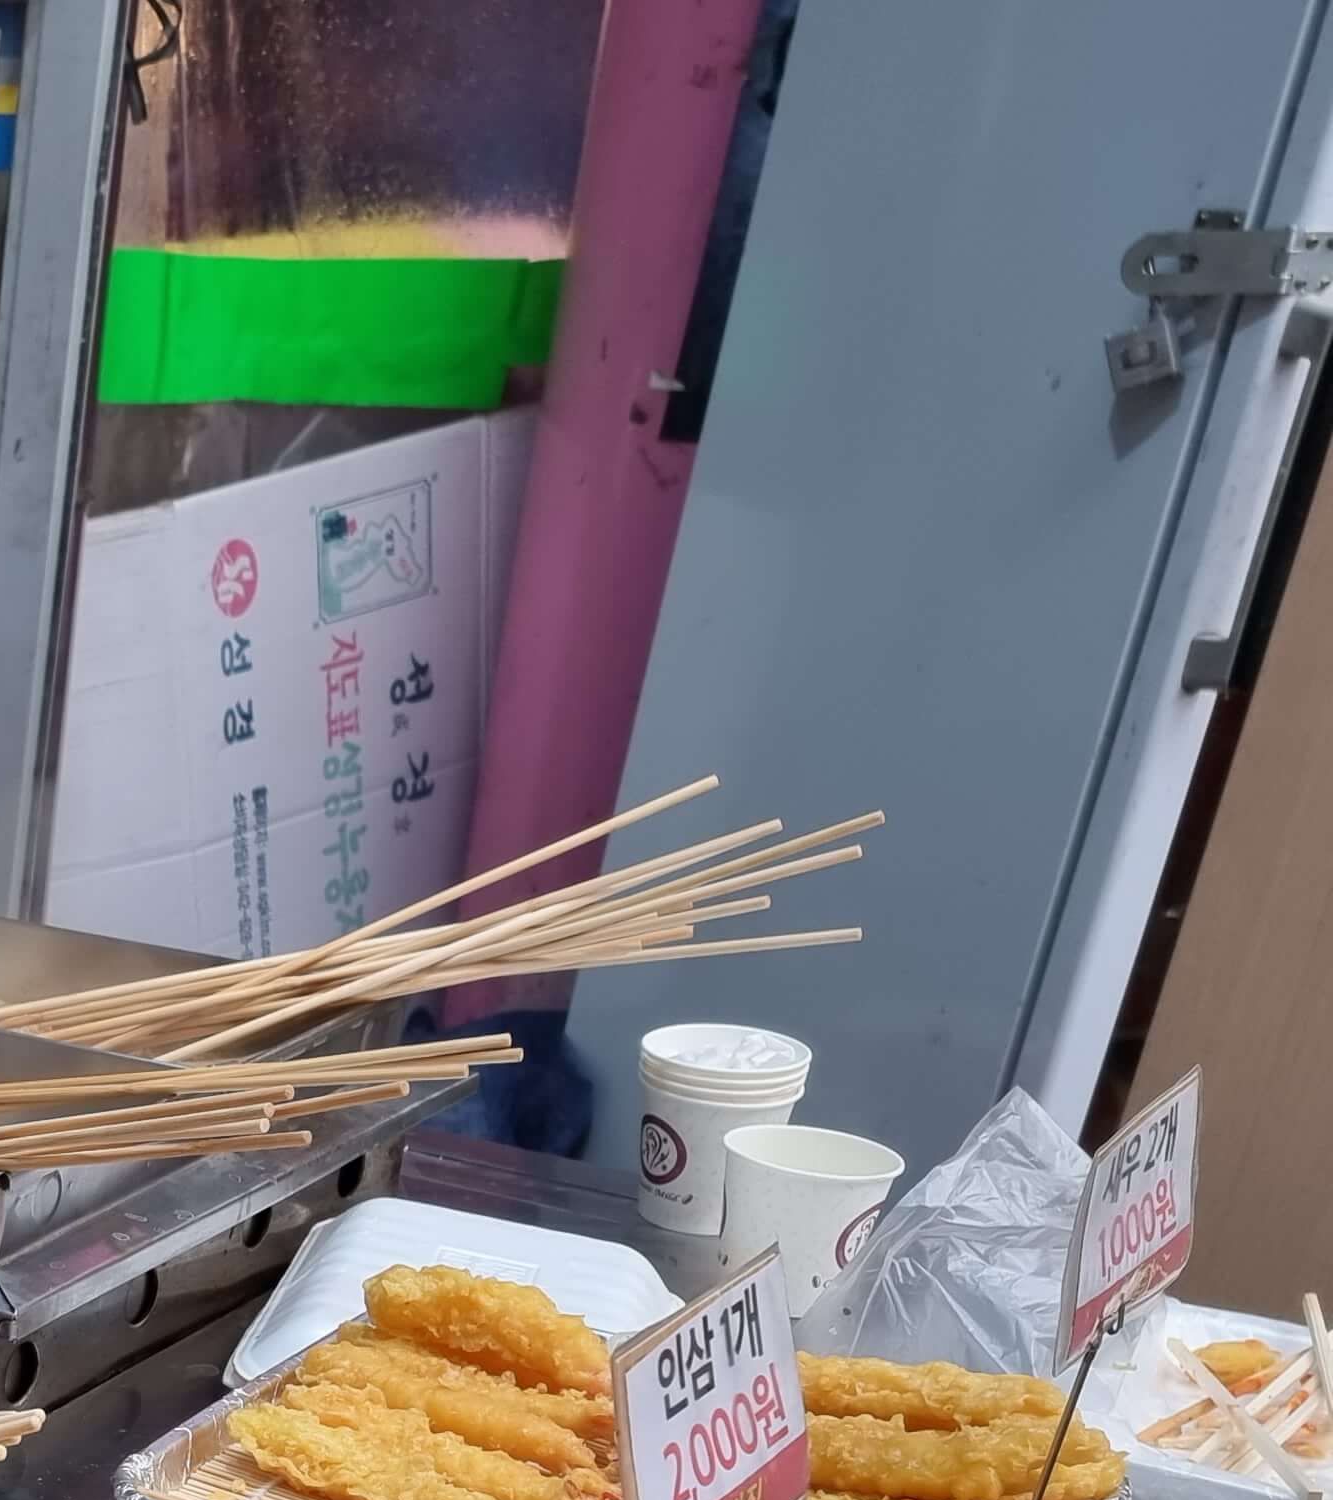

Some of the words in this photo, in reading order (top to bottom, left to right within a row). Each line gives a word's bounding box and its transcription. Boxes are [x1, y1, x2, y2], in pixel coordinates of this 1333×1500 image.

[1101, 1133, 1142, 1204] 새우
[1143, 1102, 1180, 1173] 2개
[1096, 1168, 1178, 1283] 1,000원
[657, 1315, 716, 1421] 인삼
[720, 1282, 764, 1368] 1개
